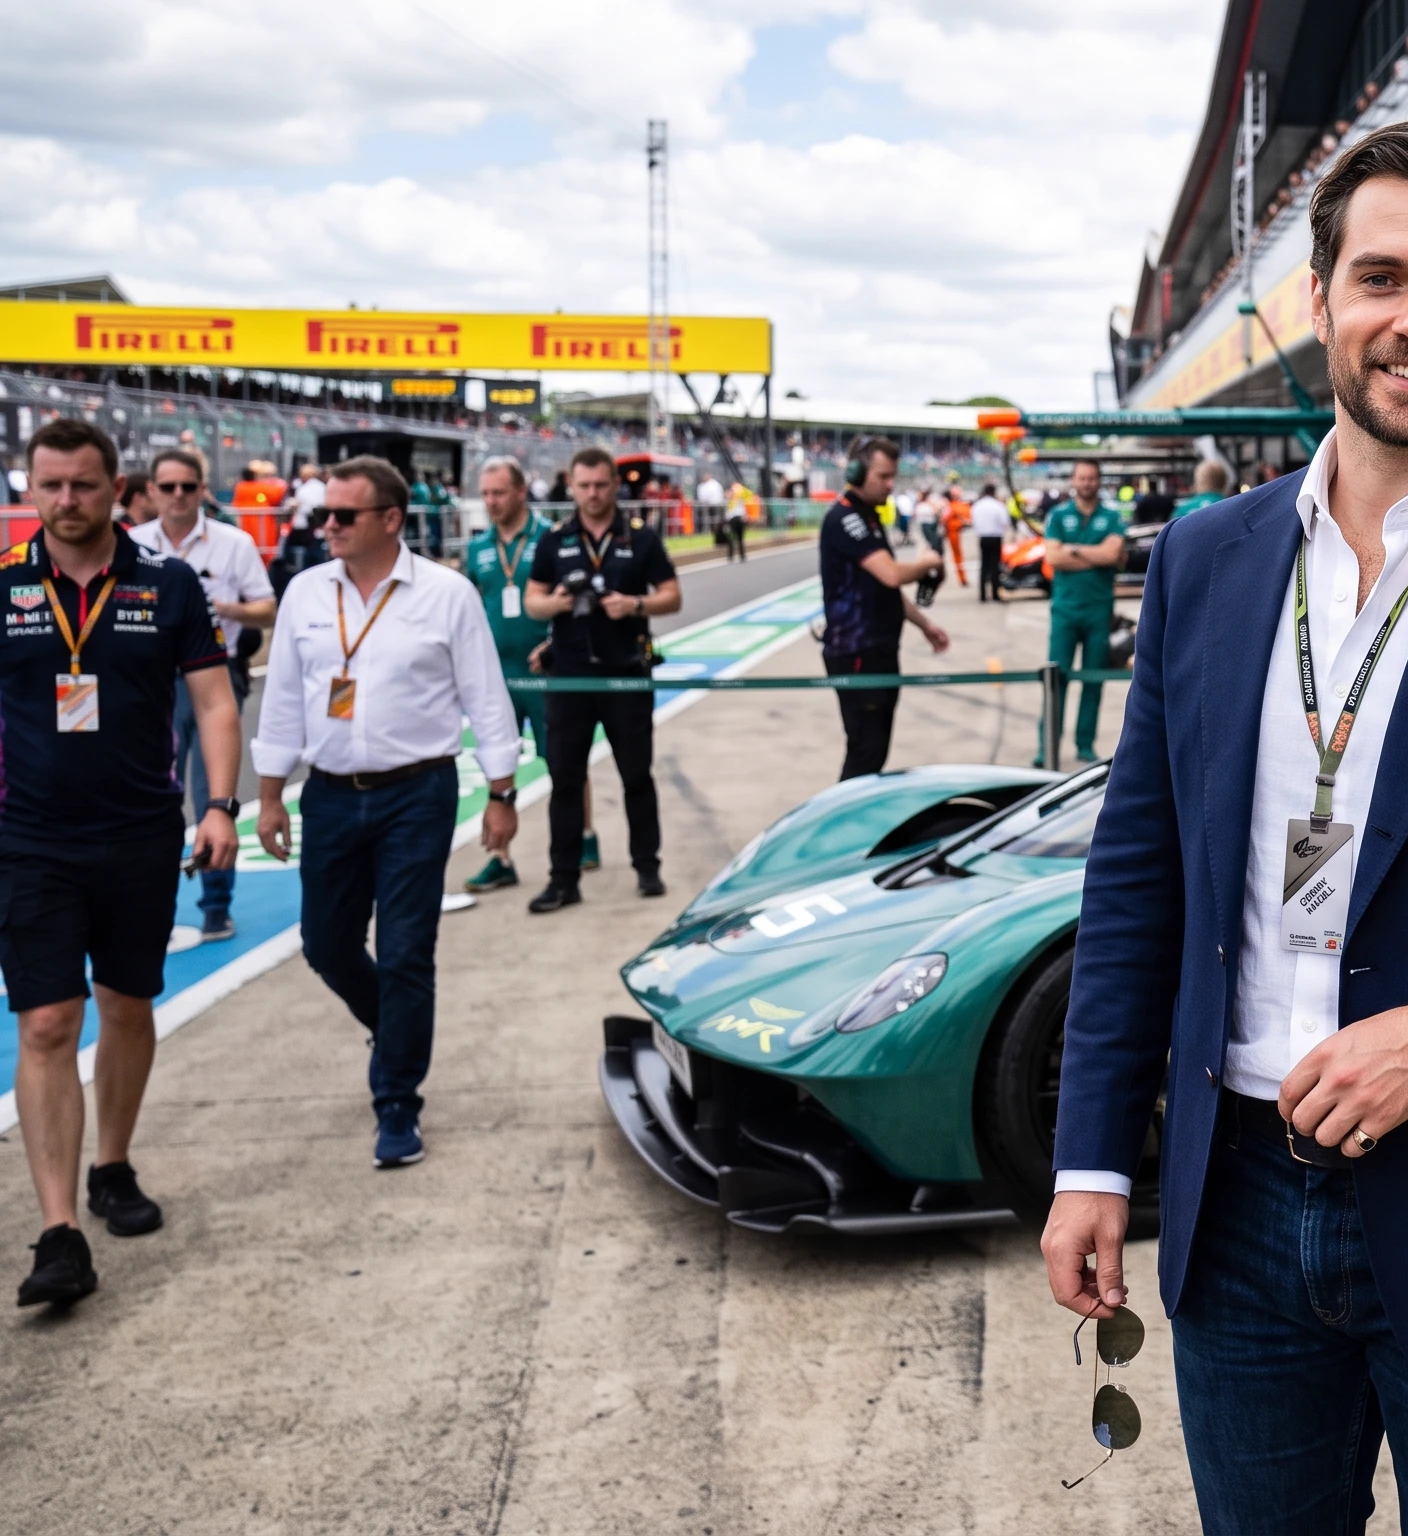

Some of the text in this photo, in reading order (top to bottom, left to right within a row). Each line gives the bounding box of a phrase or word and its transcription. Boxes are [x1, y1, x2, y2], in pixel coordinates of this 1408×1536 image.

[76, 314, 234, 352] PIRELLI
[307, 319, 460, 356] PIRELLI
[532, 324, 682, 359] PIRELLI
[750, 892, 848, 938] 5
